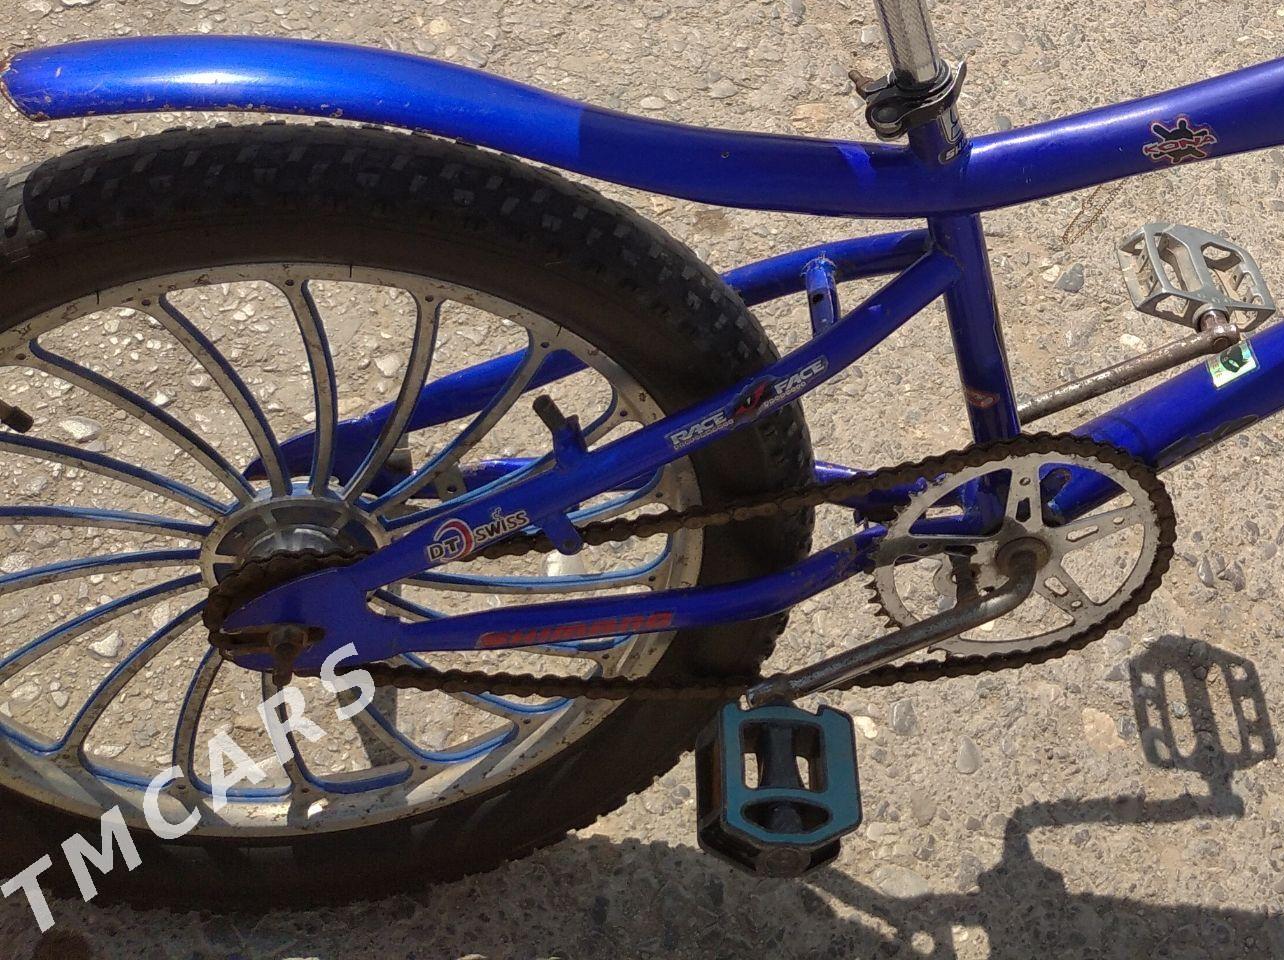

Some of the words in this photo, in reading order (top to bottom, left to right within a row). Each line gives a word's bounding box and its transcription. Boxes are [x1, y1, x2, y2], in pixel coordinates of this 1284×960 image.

[669, 410, 727, 445] RACE
[774, 358, 826, 394] FACE
[427, 535, 461, 561] DT
[473, 510, 530, 543] SWISS
